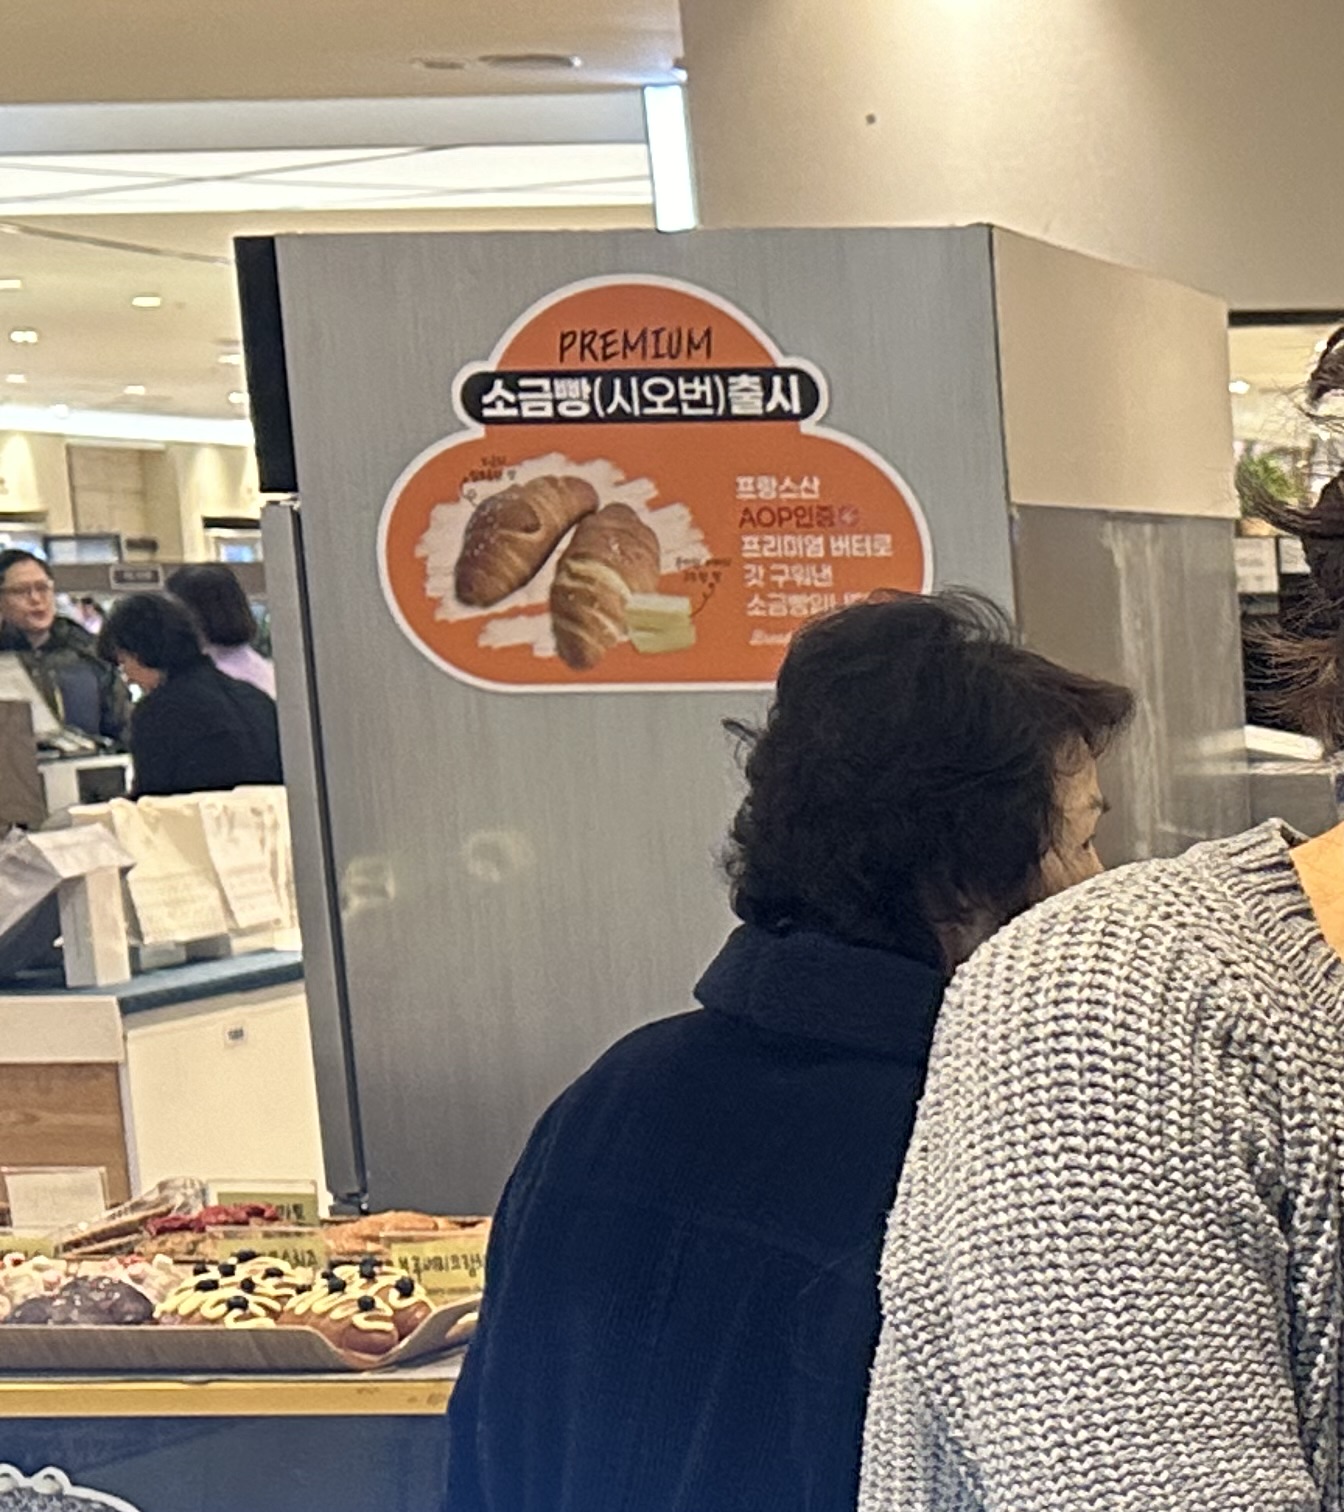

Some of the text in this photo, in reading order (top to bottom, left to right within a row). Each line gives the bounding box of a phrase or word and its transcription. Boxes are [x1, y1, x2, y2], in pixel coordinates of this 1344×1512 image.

[558, 326, 714, 363] PREMIUM
[480, 373, 802, 418] 소금빵(시오번)출시
[736, 475, 820, 500] 프랑스산
[741, 533, 893, 558] 프리미엄 버터로
